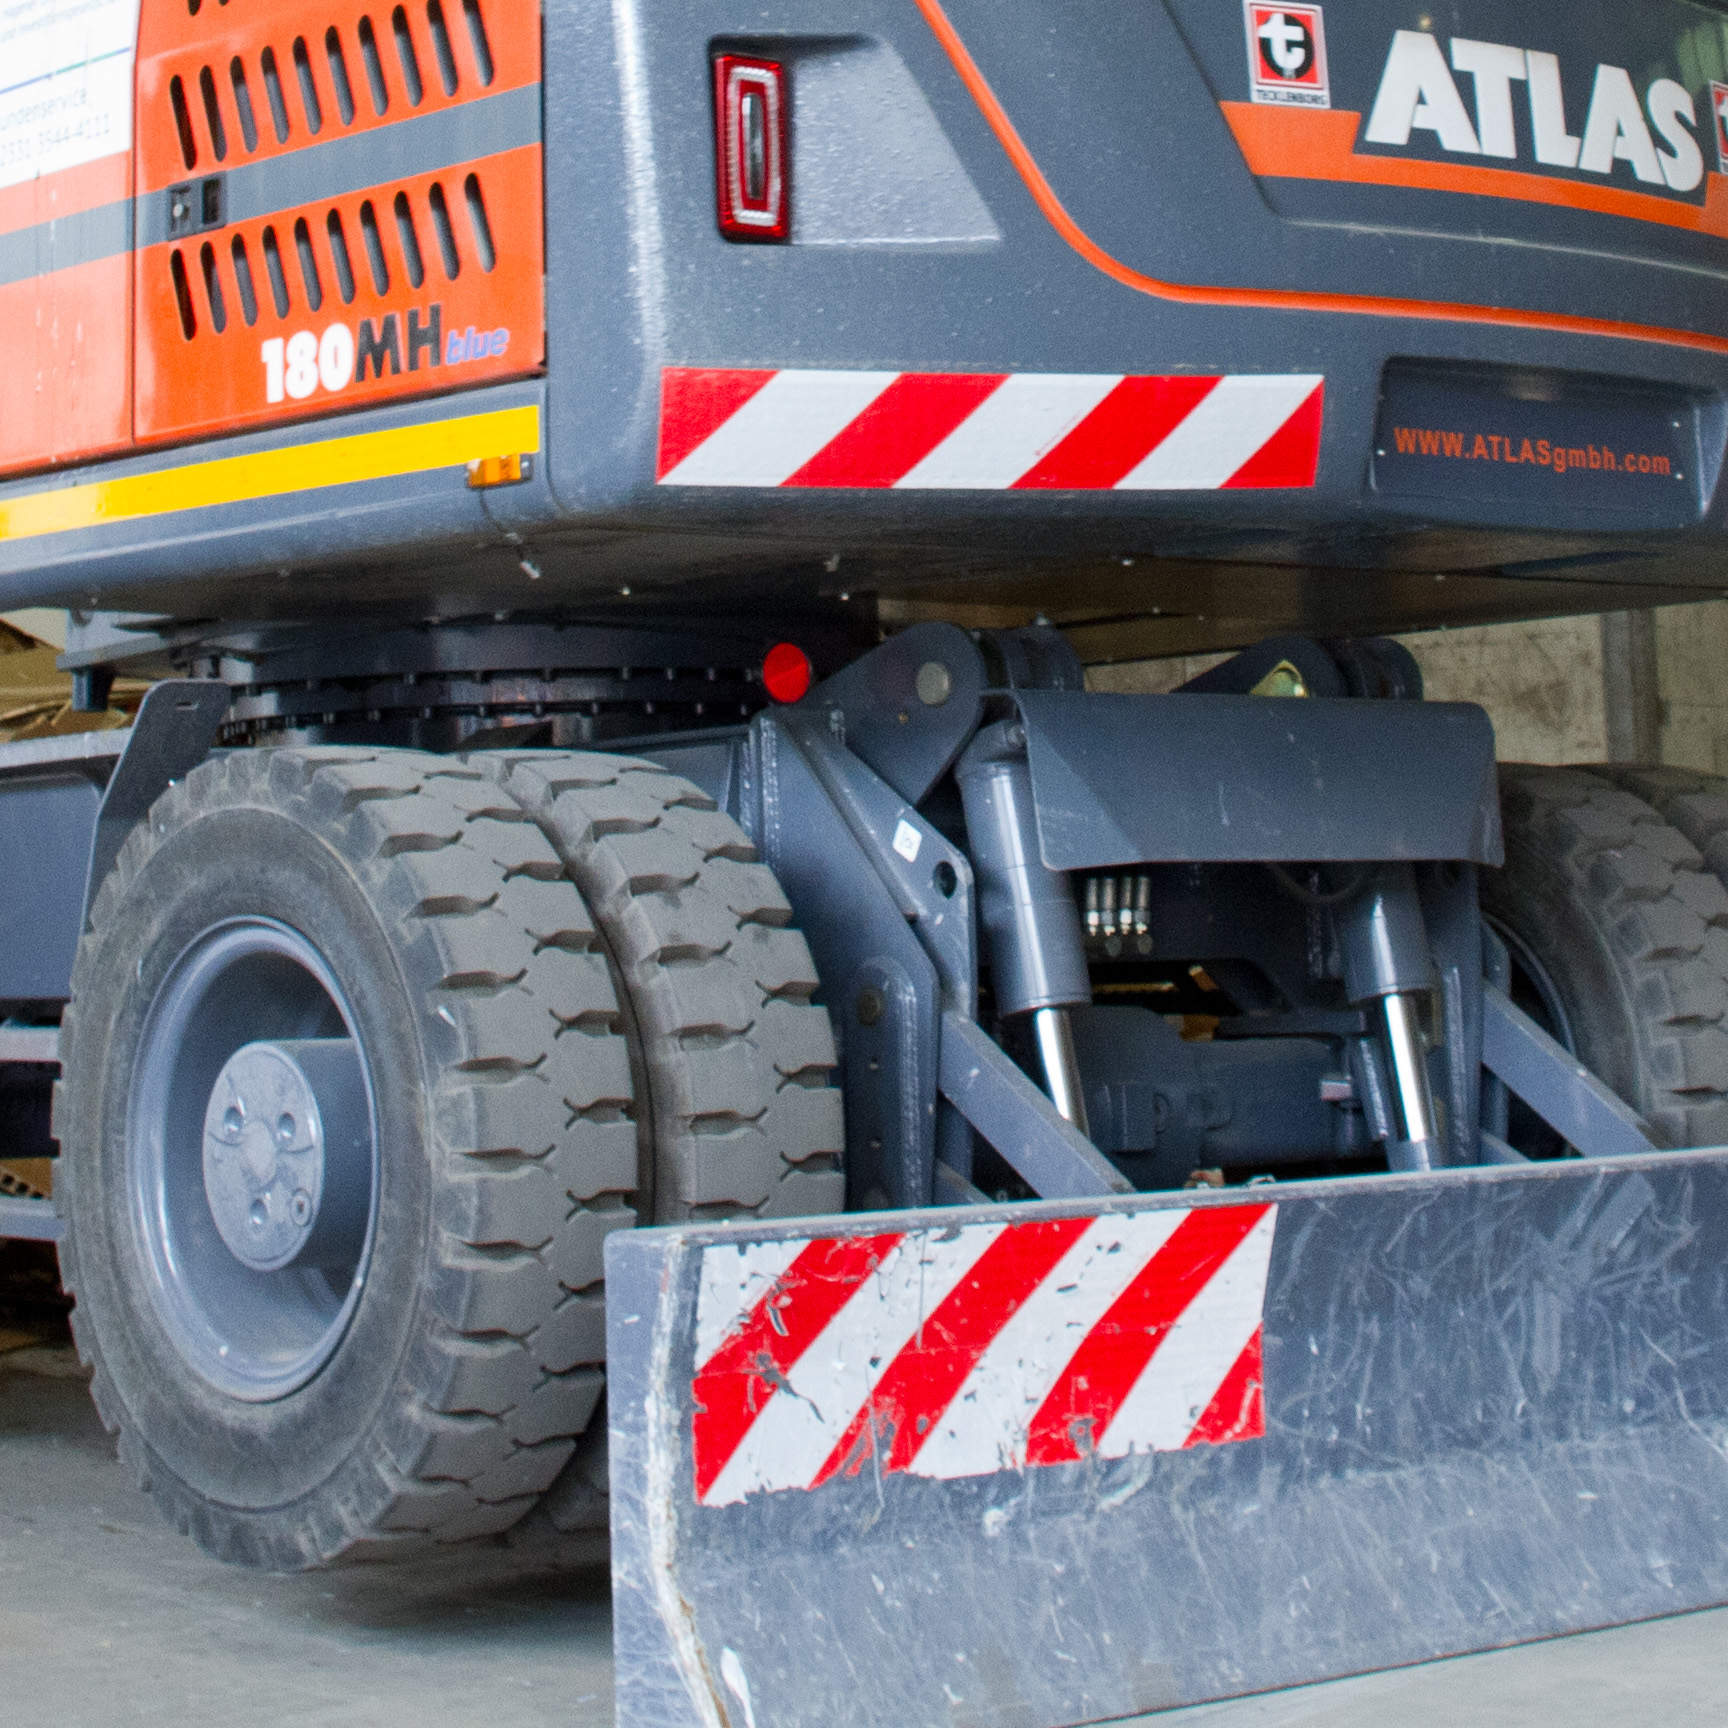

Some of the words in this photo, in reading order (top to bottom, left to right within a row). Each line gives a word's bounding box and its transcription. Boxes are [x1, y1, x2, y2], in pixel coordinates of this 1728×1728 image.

[1364, 29, 1704, 192] ATLAS
[37, 112, 110, 156] 3544-4111
[446, 325, 510, 365] blue
